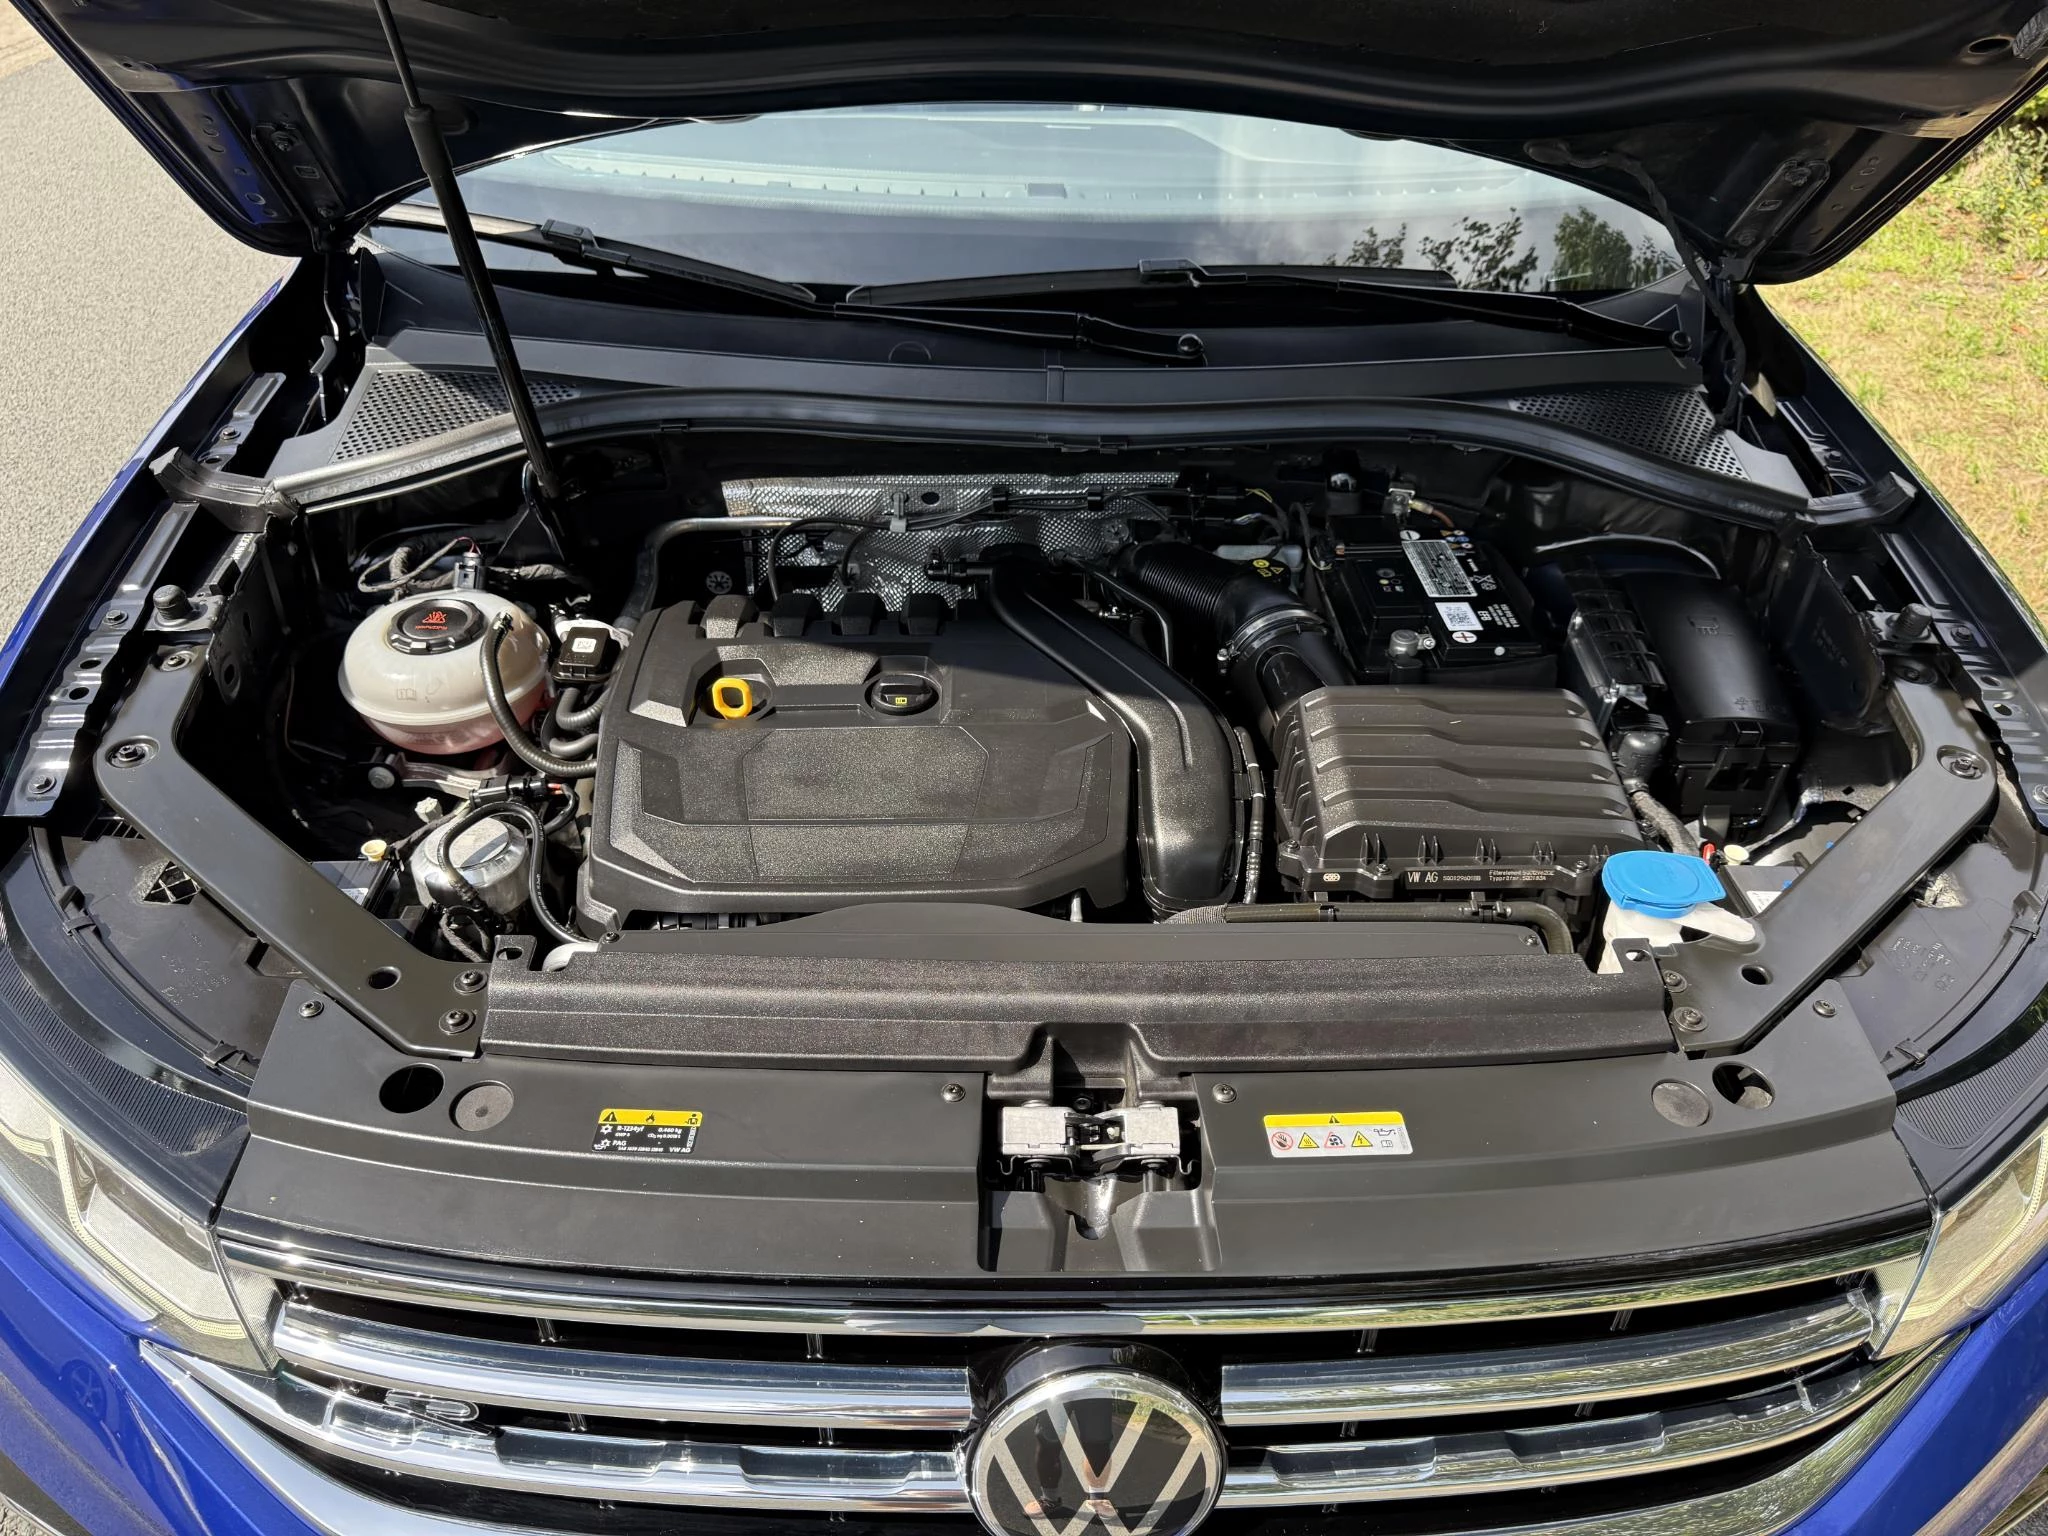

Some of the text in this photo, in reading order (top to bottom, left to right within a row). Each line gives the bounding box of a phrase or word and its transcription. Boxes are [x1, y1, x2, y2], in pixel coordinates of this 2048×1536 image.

[1477, 610, 1492, 621] EFB
[1407, 871, 1421, 883] VW
[1424, 871, 1439, 883] AG
[616, 1125, 645, 1134] R-1234yf
